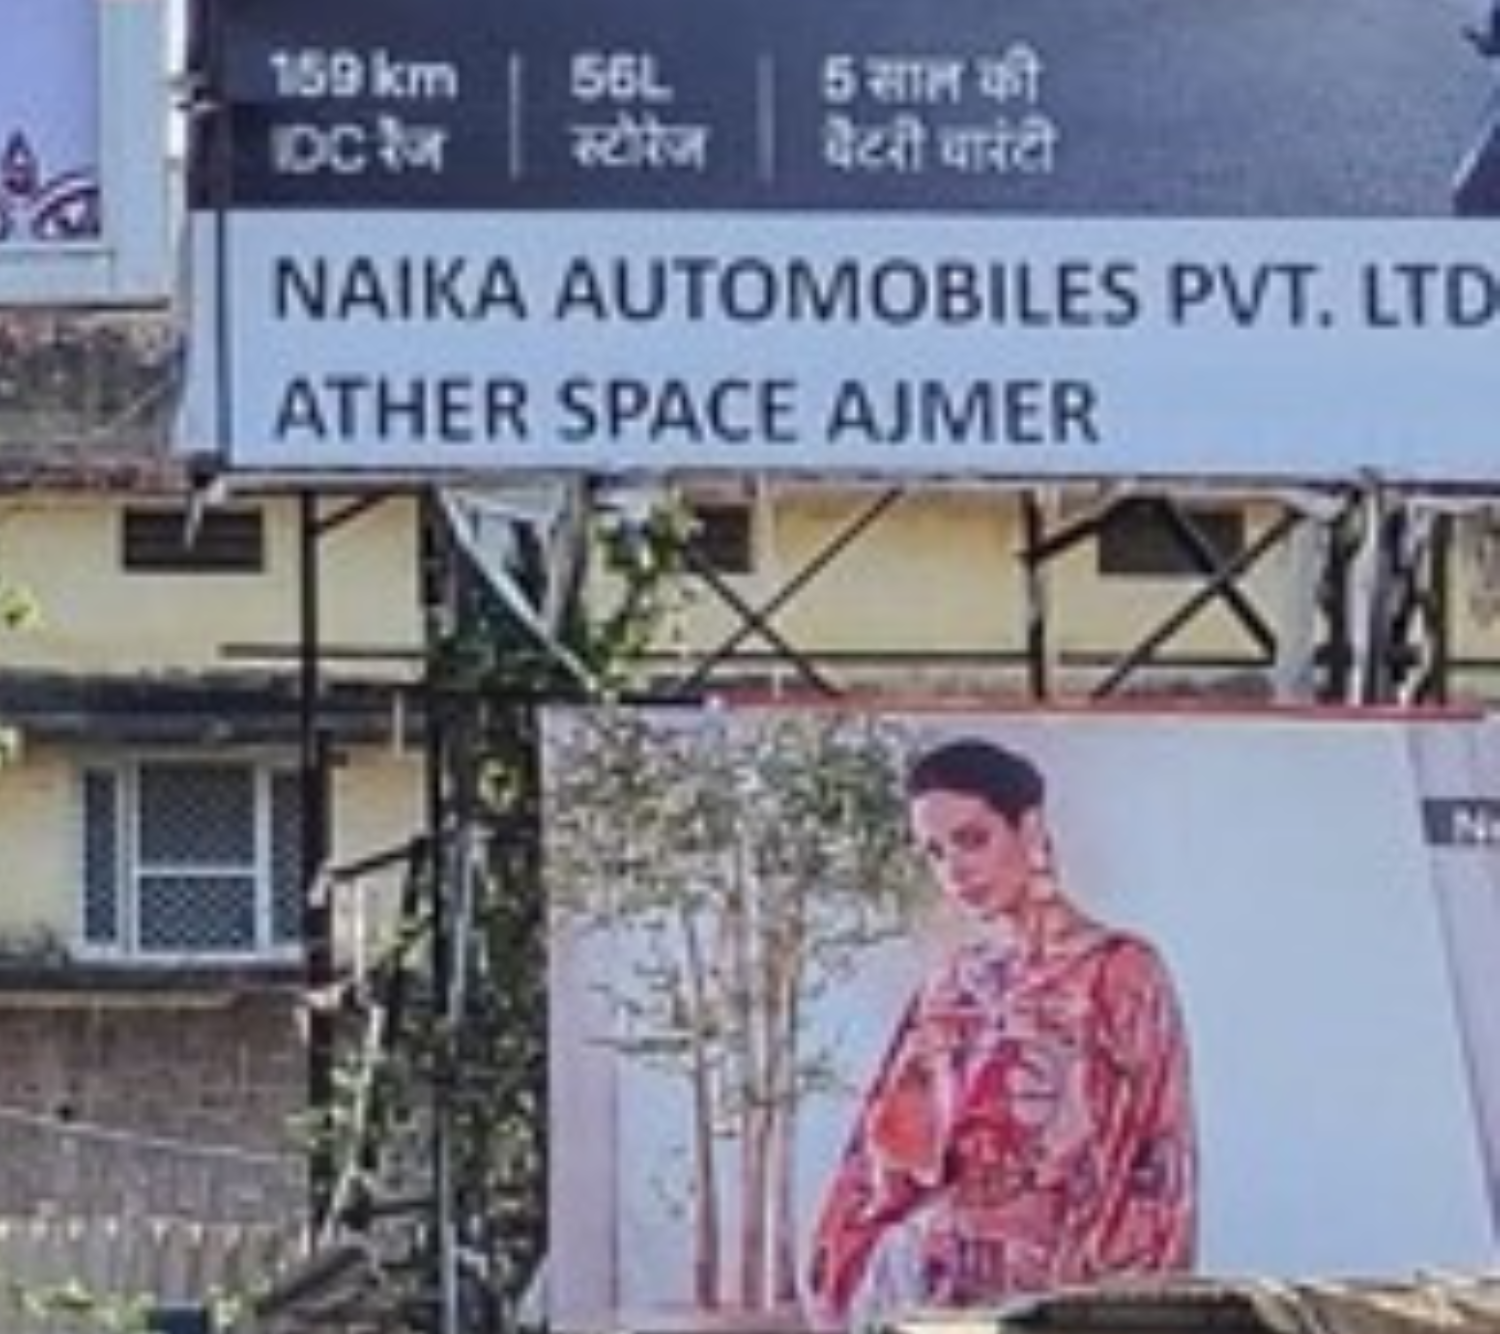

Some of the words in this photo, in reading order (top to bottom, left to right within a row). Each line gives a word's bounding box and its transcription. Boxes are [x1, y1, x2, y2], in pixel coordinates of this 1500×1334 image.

[270, 48, 363, 99] 159
[370, 47, 460, 101] km
[824, 55, 855, 104] 5
[866, 55, 963, 104] साल
[978, 40, 1043, 103] की
[273, 256, 528, 322] NAIKA
[555, 257, 1140, 327] AUTOMOBILES
[1168, 263, 1333, 329] PVT.
[1365, 263, 1500, 329] LTD
[274, 378, 530, 442] ATHER
[558, 378, 798, 443] SPACE
[826, 380, 1100, 445] AJMER
